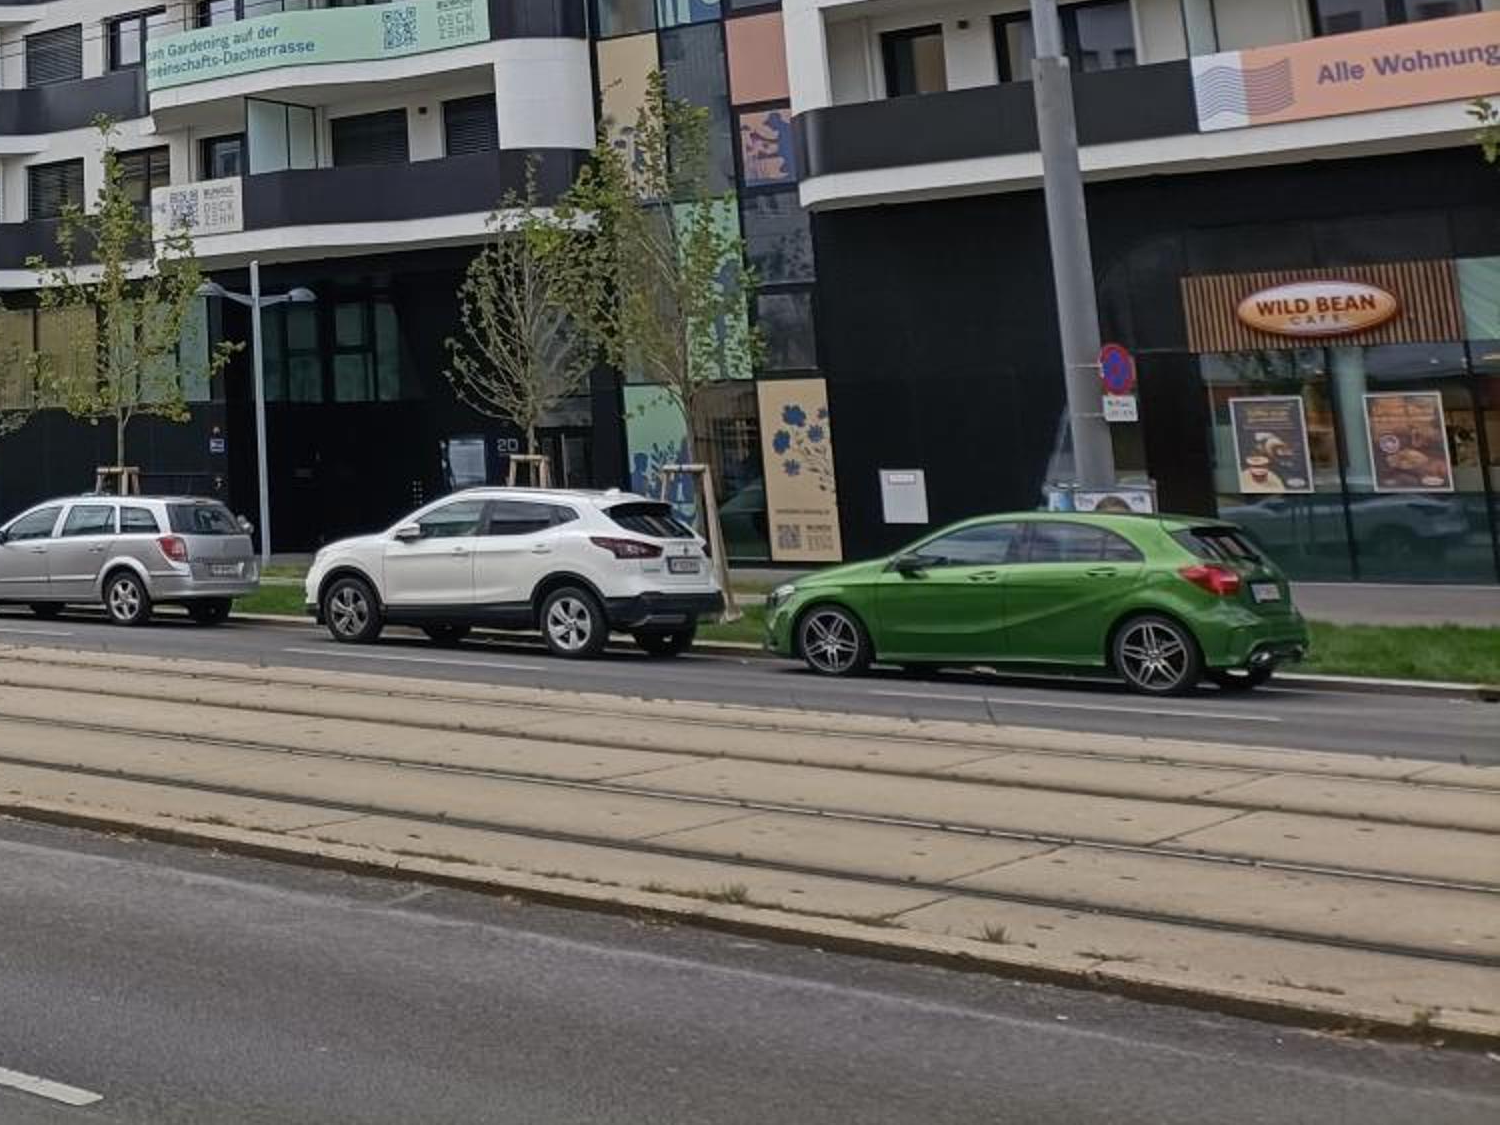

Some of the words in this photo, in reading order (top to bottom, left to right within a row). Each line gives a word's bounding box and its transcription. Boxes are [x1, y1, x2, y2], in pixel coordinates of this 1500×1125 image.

[167, 35, 231, 57] Gardening
[233, 27, 253, 44] auf
[257, 26, 279, 39] der
[1317, 61, 1365, 85] Alle
[1256, 298, 1310, 316] WILD
[1315, 294, 1377, 313] BEAN
